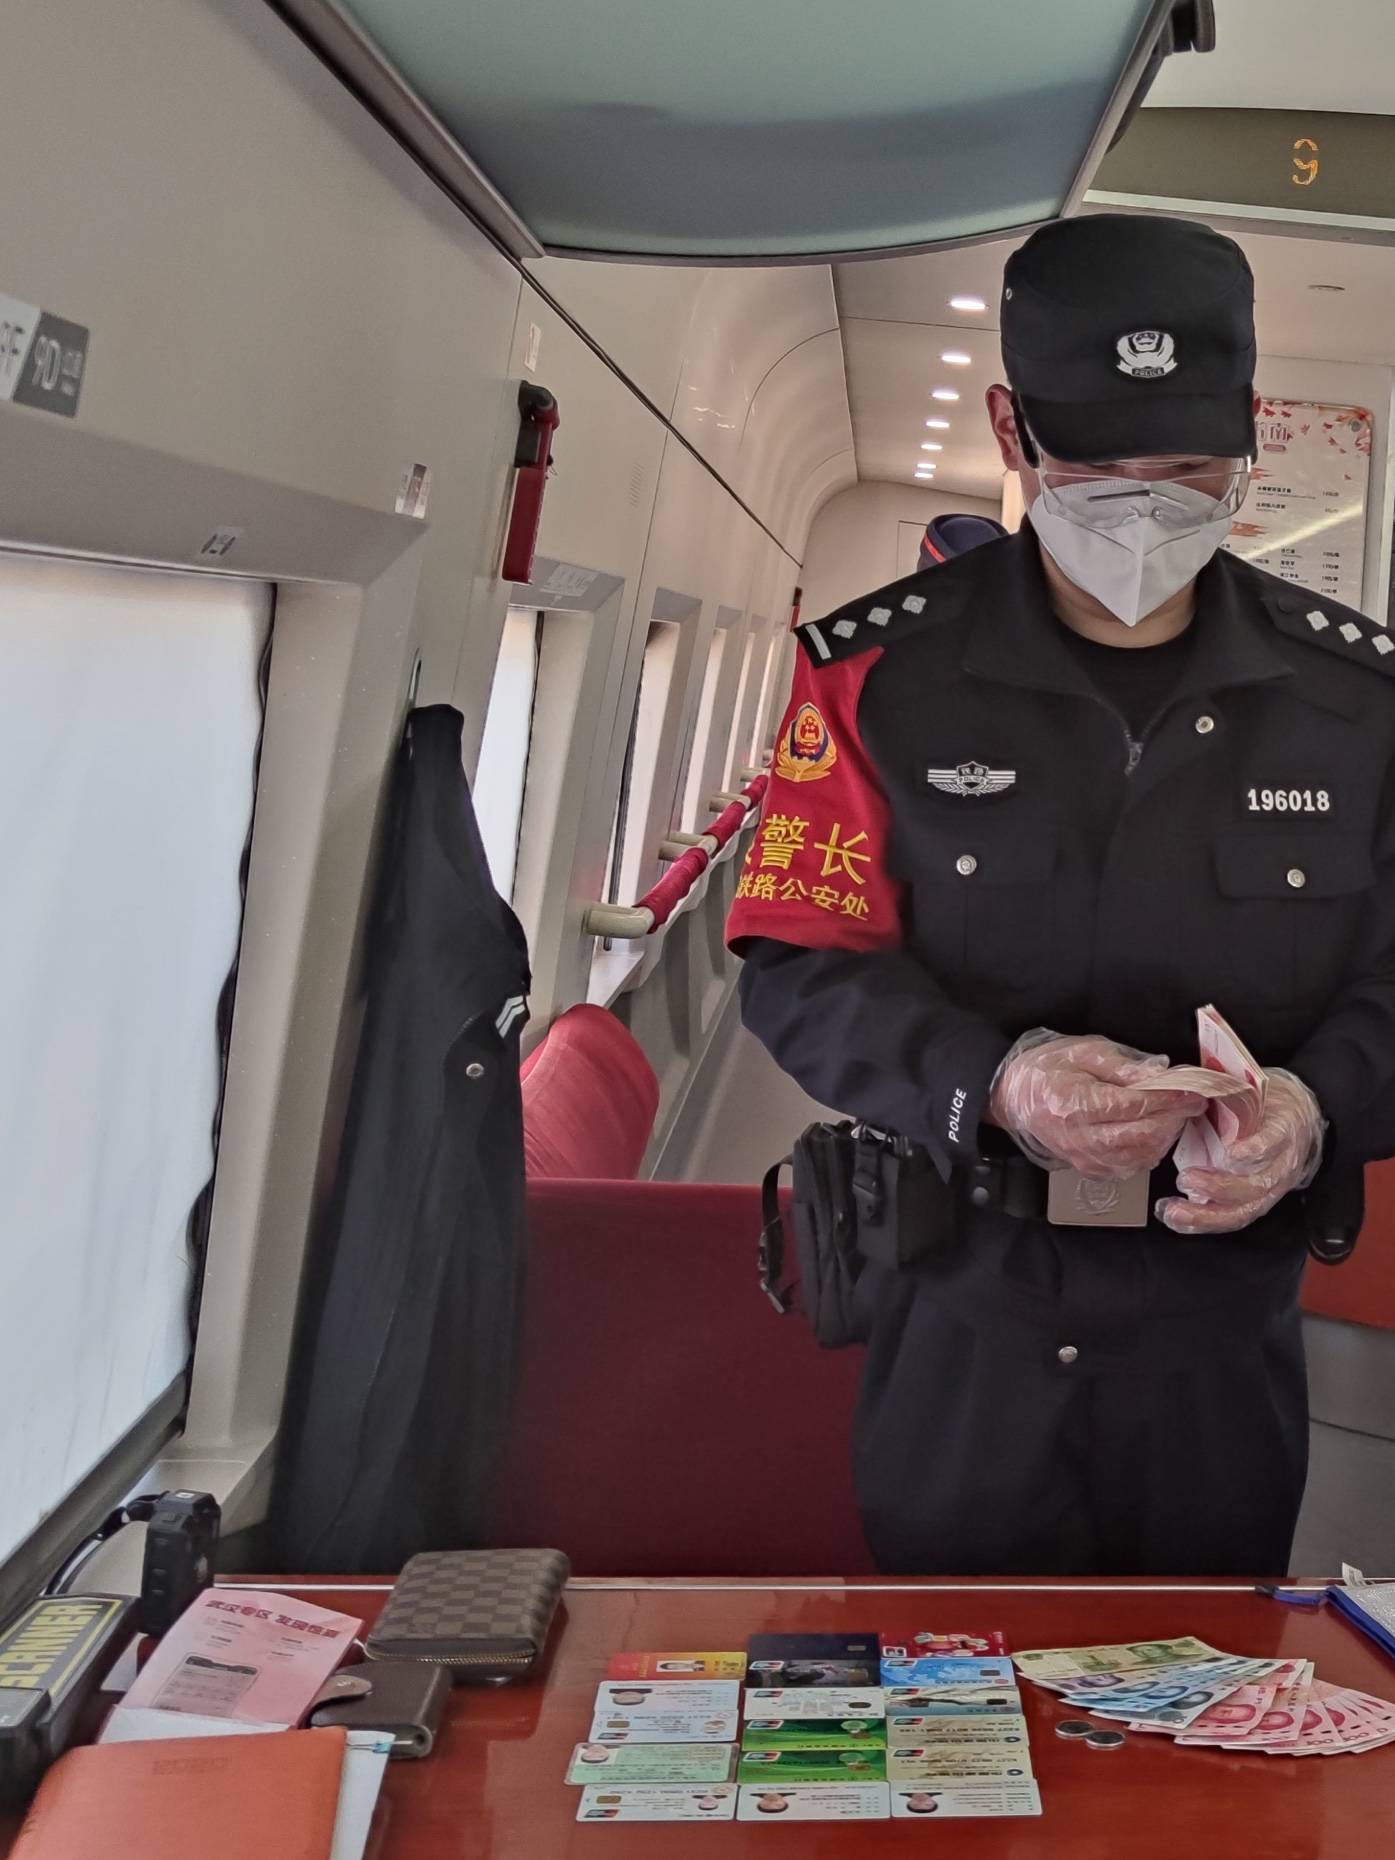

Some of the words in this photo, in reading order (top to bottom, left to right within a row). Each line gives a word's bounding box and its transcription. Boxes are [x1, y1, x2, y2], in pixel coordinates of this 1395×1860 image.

[1292, 138, 1319, 185] 9
[1247, 788, 1330, 811] 196018
[744, 812, 872, 886] 警长
[735, 871, 870, 921] 铁路公安处
[947, 1087, 967, 1143] POLICE
